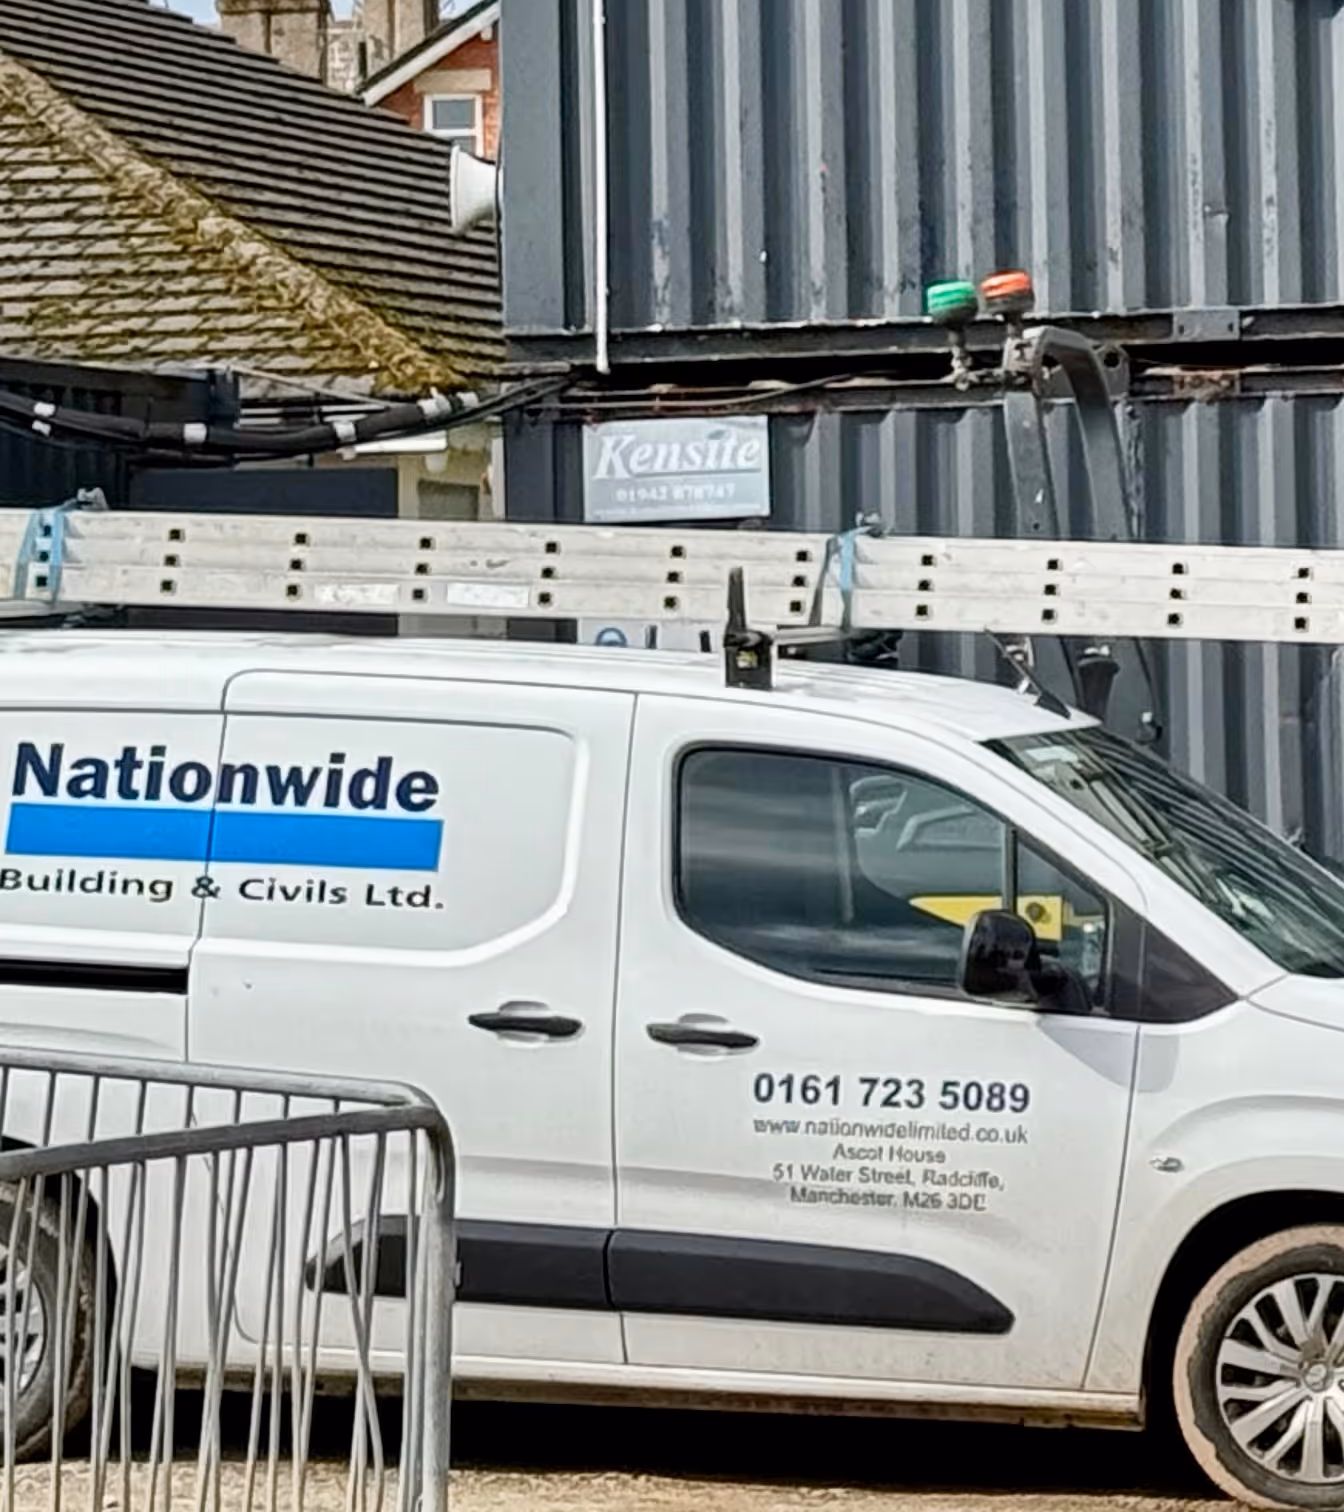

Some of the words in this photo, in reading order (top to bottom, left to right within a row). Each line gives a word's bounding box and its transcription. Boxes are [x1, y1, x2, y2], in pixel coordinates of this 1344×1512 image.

[593, 430, 761, 479] Kensite
[12, 742, 440, 812] Nationwide
[0, 868, 174, 903] Building
[191, 875, 221, 899] &
[238, 877, 347, 905] Civils
[365, 883, 444, 909] Ltd.
[753, 1073, 842, 1106] 0161
[858, 1076, 926, 1109] 723
[938, 1080, 1031, 1114] 5089
[753, 1117, 1028, 1144] www.nationwidelimited.co.uk
[832, 1144, 884, 1161] Ascot
[888, 1146, 946, 1164] House
[772, 1164, 794, 1181] 51
[800, 1165, 852, 1183] Water
[903, 1191, 943, 1209] M26
[947, 1194, 987, 1211] 3DE
